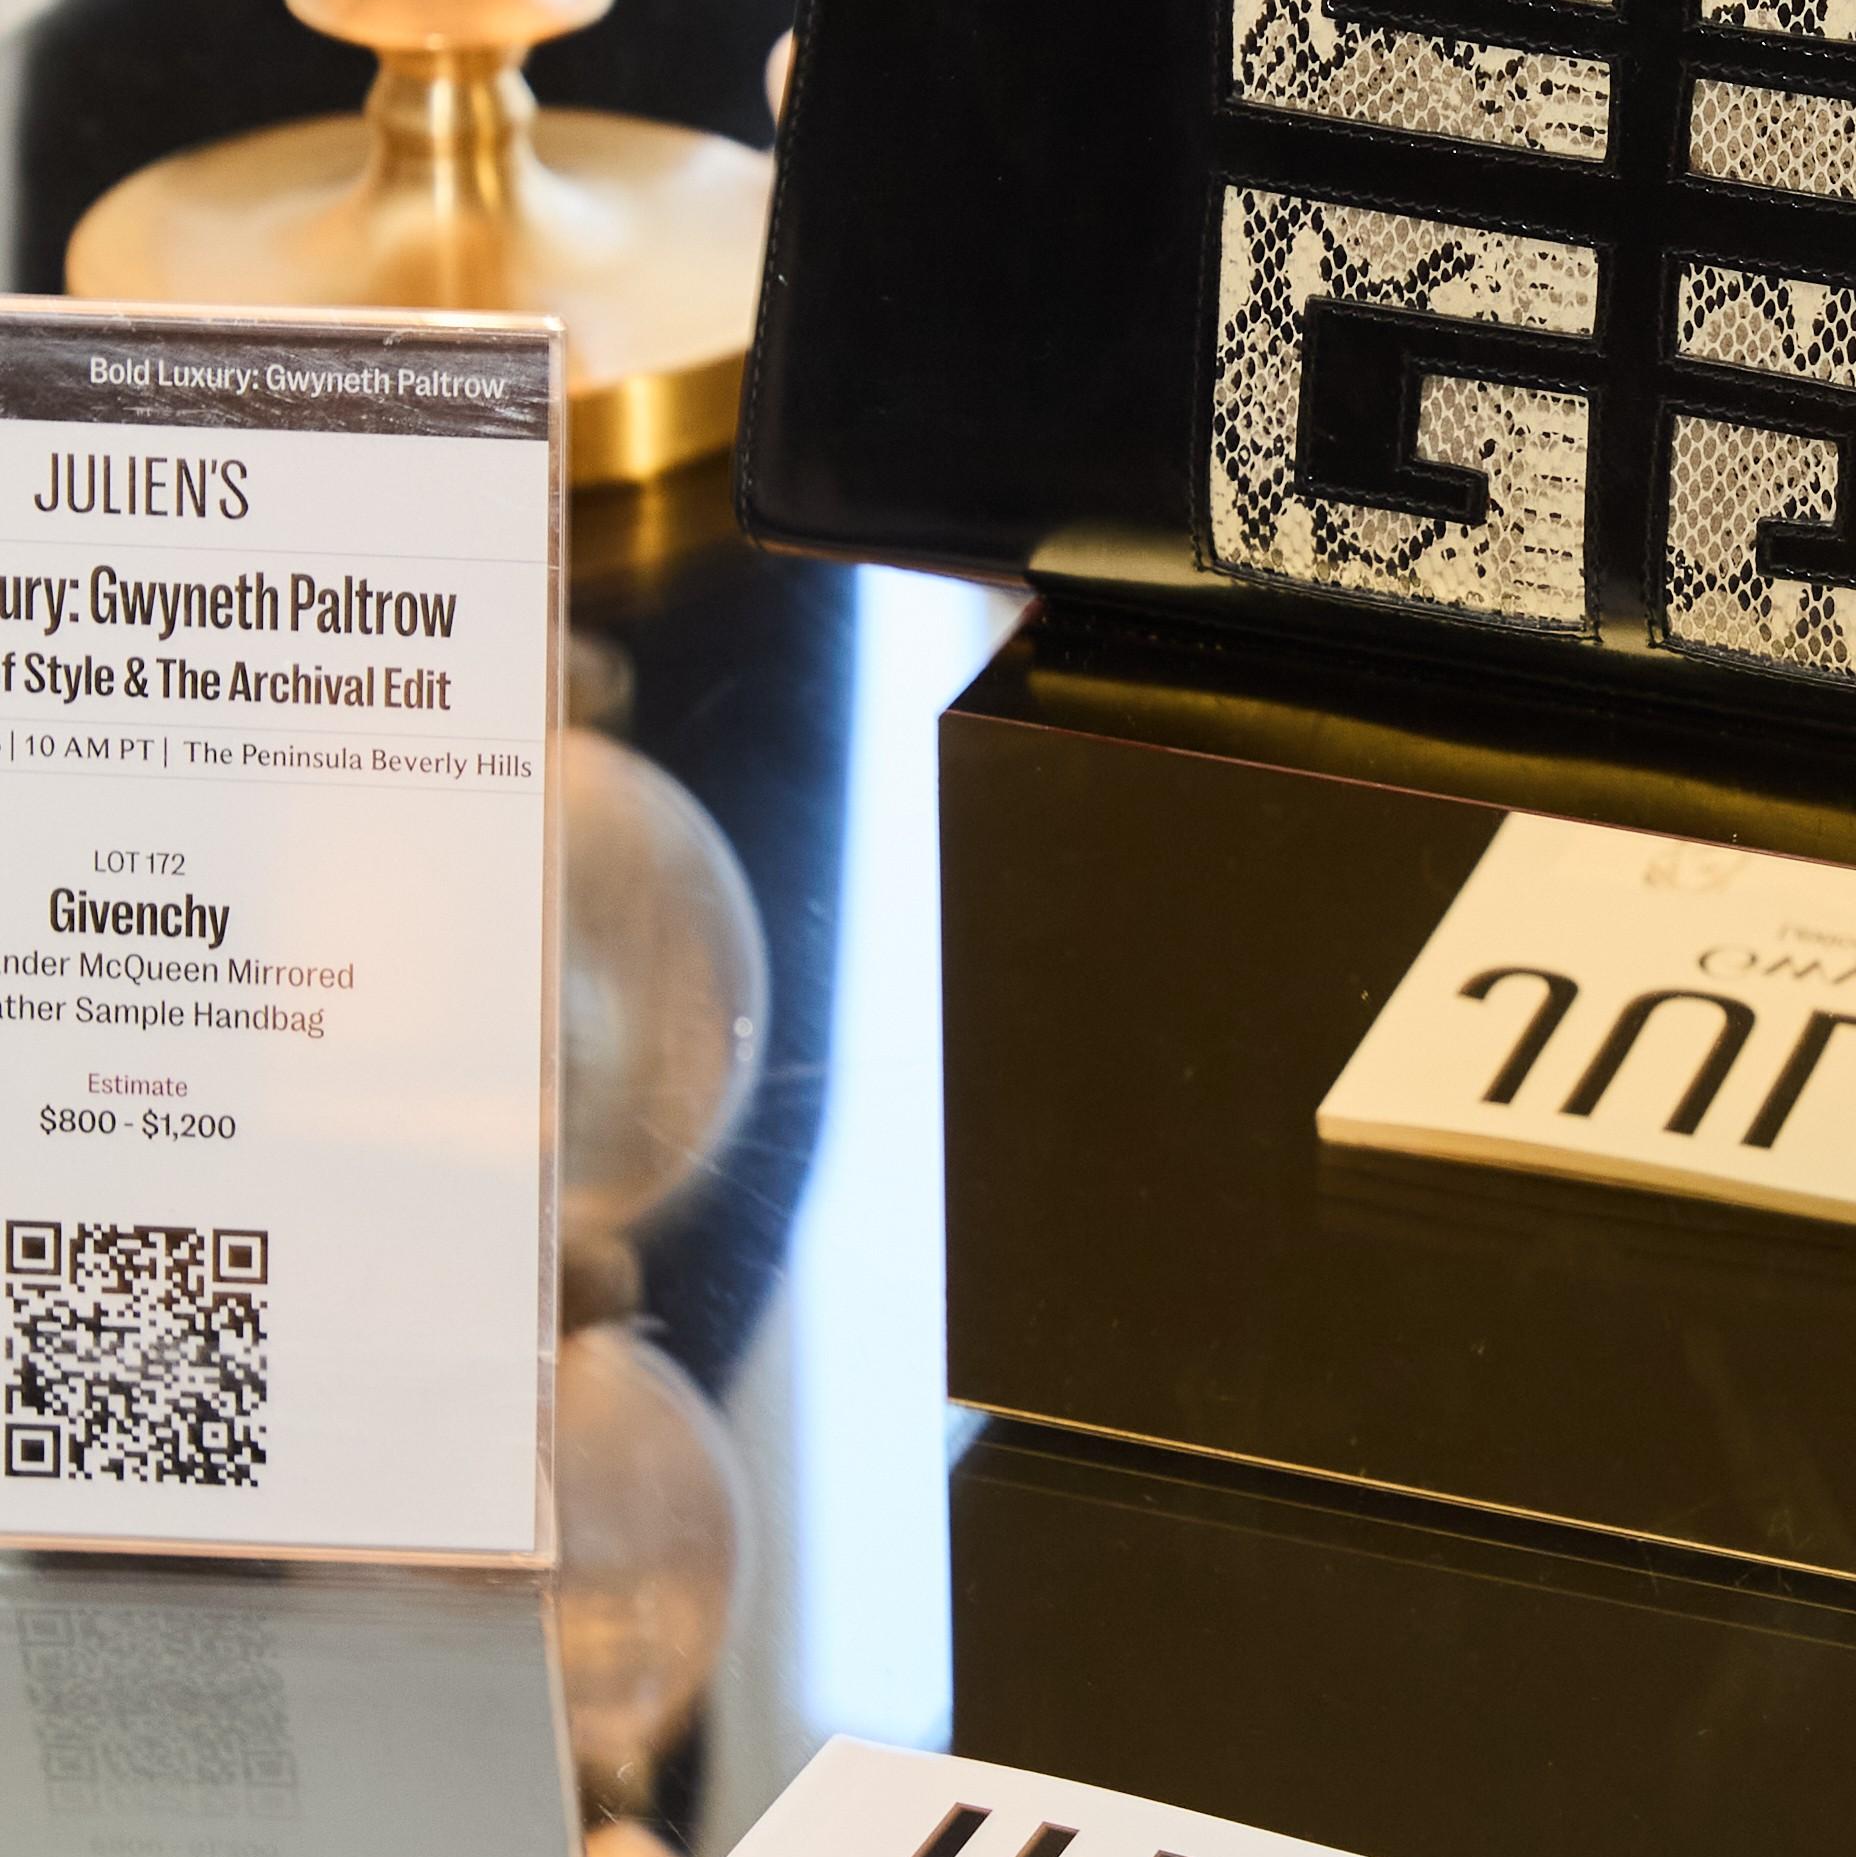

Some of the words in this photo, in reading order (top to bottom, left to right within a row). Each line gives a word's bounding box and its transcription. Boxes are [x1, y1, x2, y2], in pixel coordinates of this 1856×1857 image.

[90, 357, 150, 386] Bold
[158, 359, 260, 395] Luxury:
[266, 364, 391, 398] Gwyneth
[397, 369, 506, 399] Paltrow
[34, 452, 249, 520] JULIEN'S
[90, 564, 279, 641] Gwyneth
[291, 573, 457, 638] Paltrow
[24, 652, 115, 705] Style
[123, 657, 149, 699] &
[156, 658, 221, 701] The
[228, 661, 375, 708] Archival
[384, 667, 452, 711] Edit
[25, 735, 56, 758] 10
[64, 737, 110, 761] AM
[120, 738, 156, 762] PT
[183, 740, 233, 765] The
[242, 744, 362, 771] Peninsula
[372, 749, 468, 780] Beverly
[476, 753, 533, 779] Hills
[94, 849, 140, 874] LOT
[146, 851, 187, 877] 172
[49, 887, 231, 950] Givenchy
[0, 950, 71, 978] nder
[80, 952, 219, 986] McQueen
[228, 958, 355, 990] Mirrored
[75, 996, 185, 1032] Sample
[193, 1001, 326, 1040] Handbag
[88, 1072, 189, 1098] Estimate
[39, 1104, 117, 1136] $800
[141, 1108, 237, 1142] $1,200
